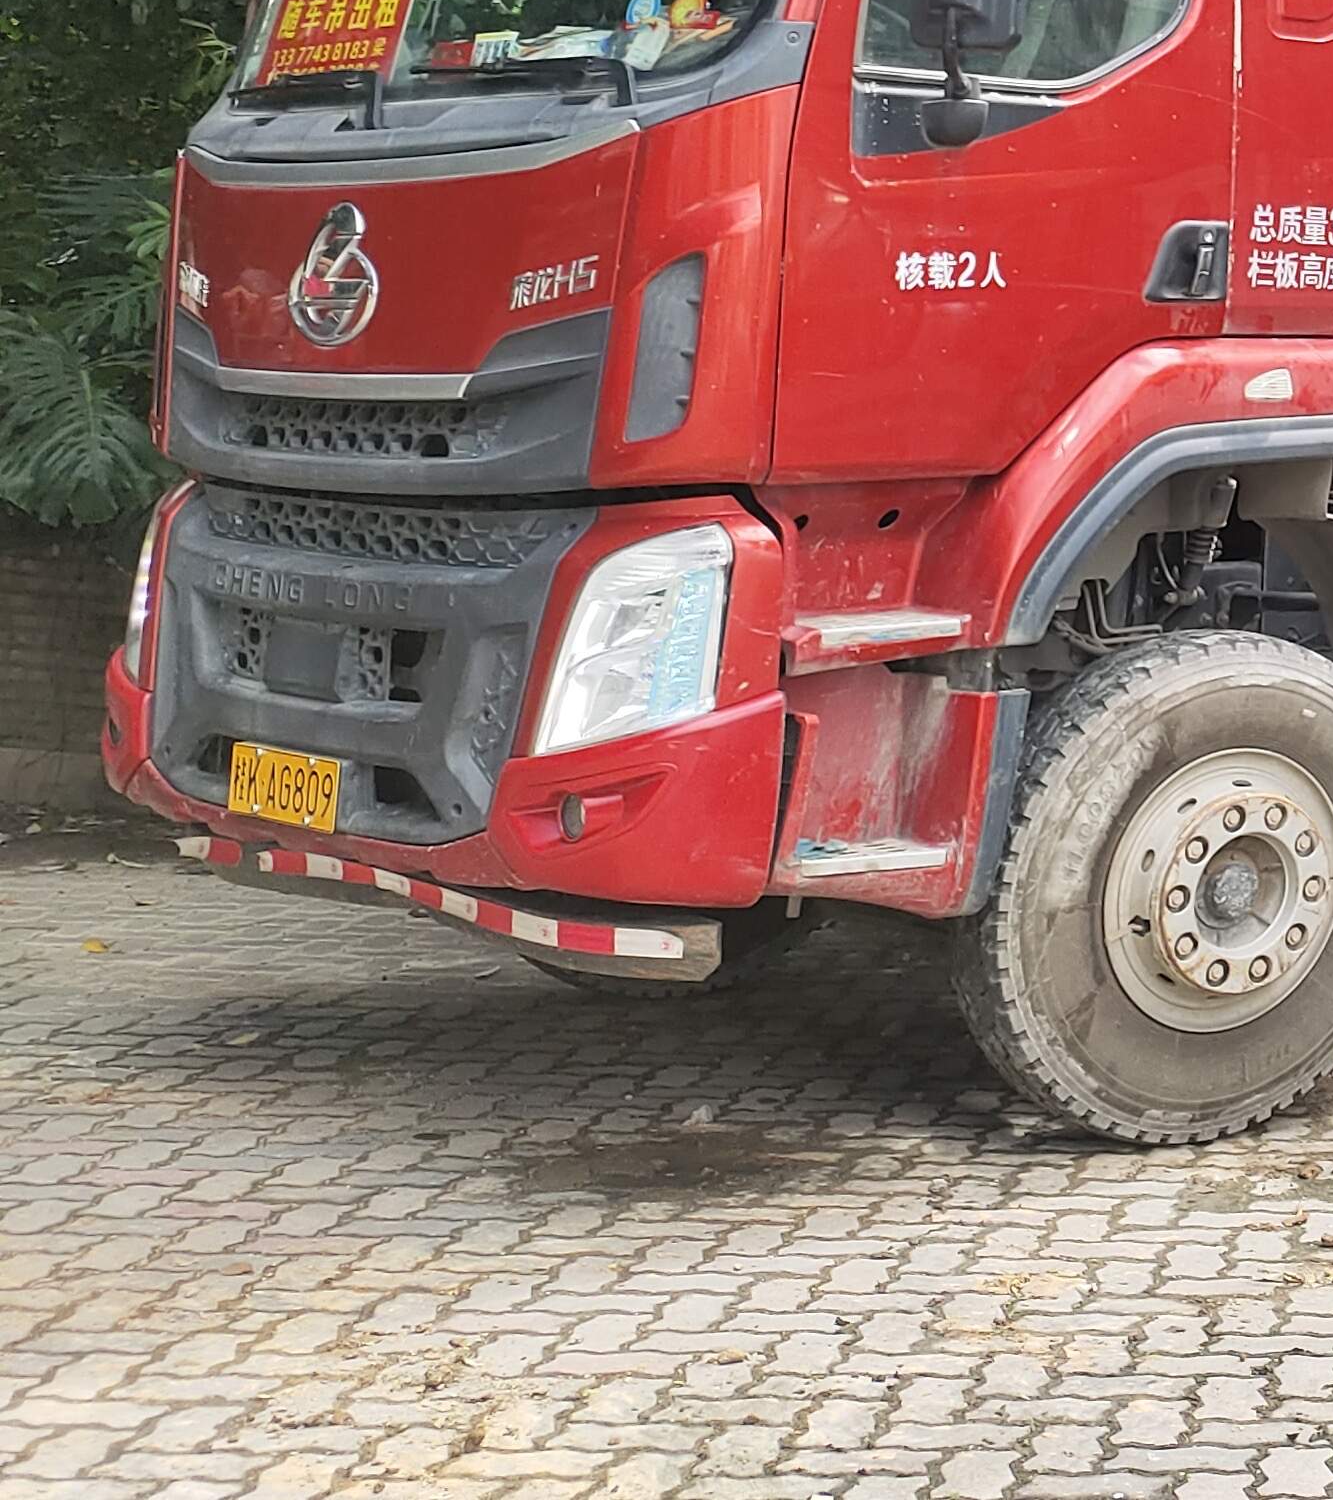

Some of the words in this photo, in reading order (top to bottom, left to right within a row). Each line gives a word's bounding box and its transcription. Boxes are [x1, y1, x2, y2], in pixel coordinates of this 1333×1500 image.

[272, 48, 295, 68] 133
[296, 44, 330, 65] 7743
[332, 39, 370, 61] 8183
[894, 250, 1007, 291] 核载2人
[211, 562, 305, 604] CHENG
[323, 578, 414, 612] LONG
